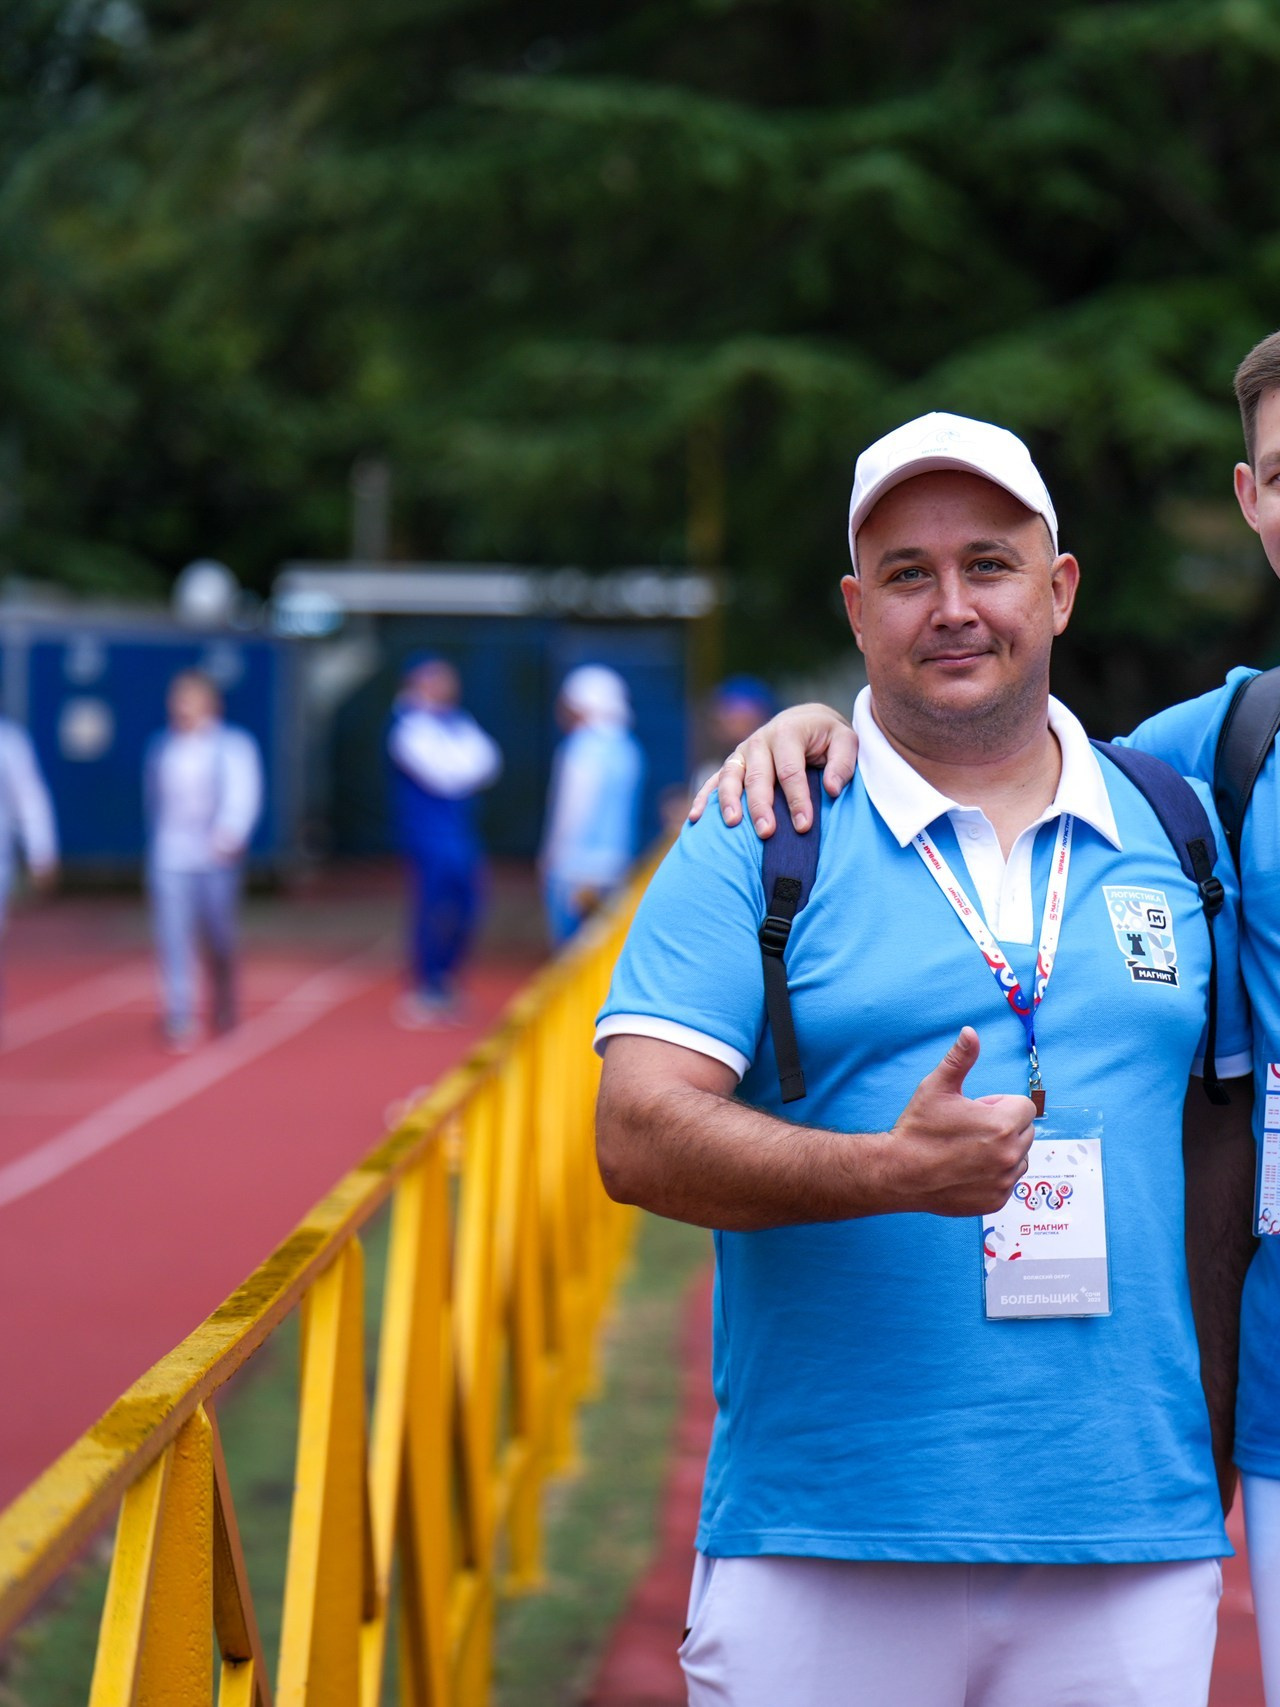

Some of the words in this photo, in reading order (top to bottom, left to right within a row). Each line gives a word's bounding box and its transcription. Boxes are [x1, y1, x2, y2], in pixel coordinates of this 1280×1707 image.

[923, 845, 942, 871] ПЕРВАЯ
[1057, 851, 1066, 875] ПЕРВАЯ
[947, 887, 965, 909] МАГНИТ
[1111, 891, 1162, 902] ЛОГИСТИКА
[1139, 970, 1172, 981] МАГНИТ
[1000, 1293, 1079, 1305] БОЛЕЛЬЩИК
